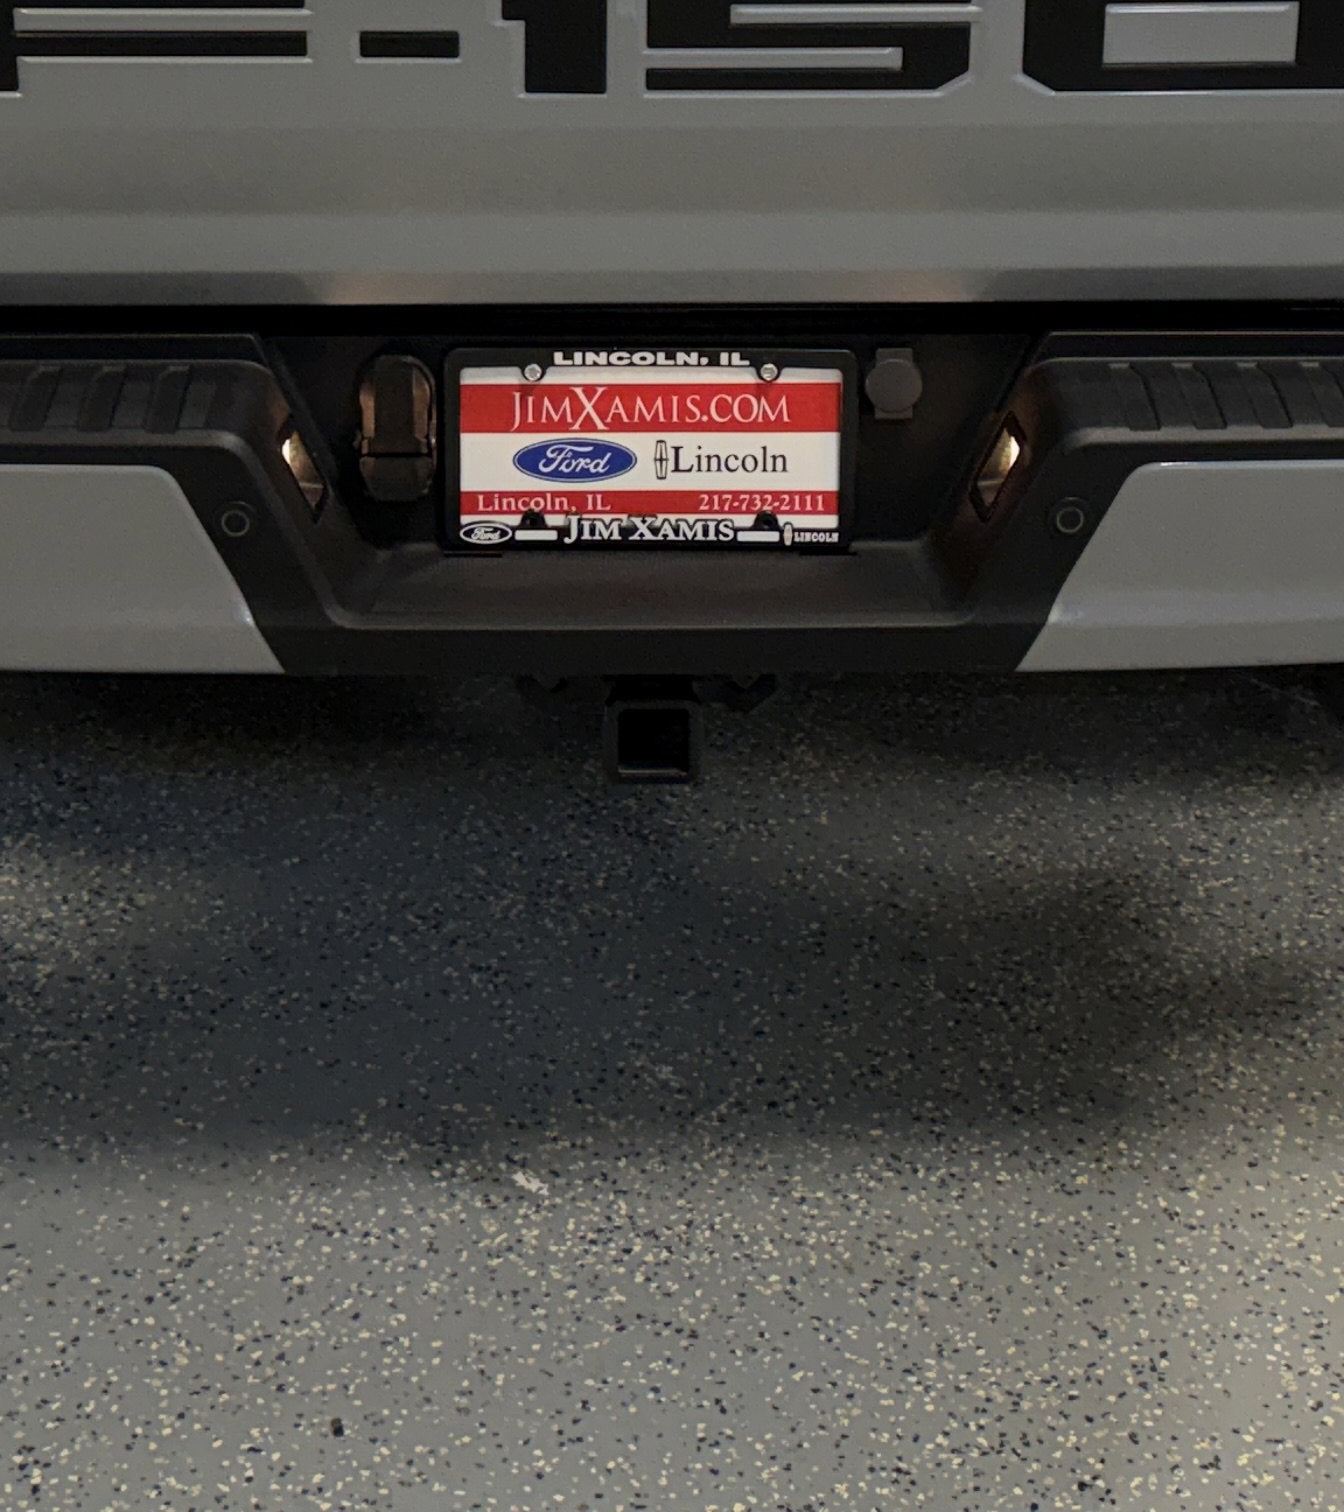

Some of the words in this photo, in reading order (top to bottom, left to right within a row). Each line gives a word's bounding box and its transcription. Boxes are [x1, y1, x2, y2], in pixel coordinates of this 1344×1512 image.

[553, 351, 709, 367] LINCOLN,
[719, 351, 750, 366] IL
[538, 444, 611, 475] Ford
[670, 445, 789, 474] Lincoln
[477, 492, 577, 513] Lincoln,
[586, 493, 612, 511] IL
[699, 493, 825, 512] 217-732-2111
[563, 515, 623, 544] JIM
[628, 517, 735, 542] XAMIS
[794, 531, 840, 543] LINCOLN
